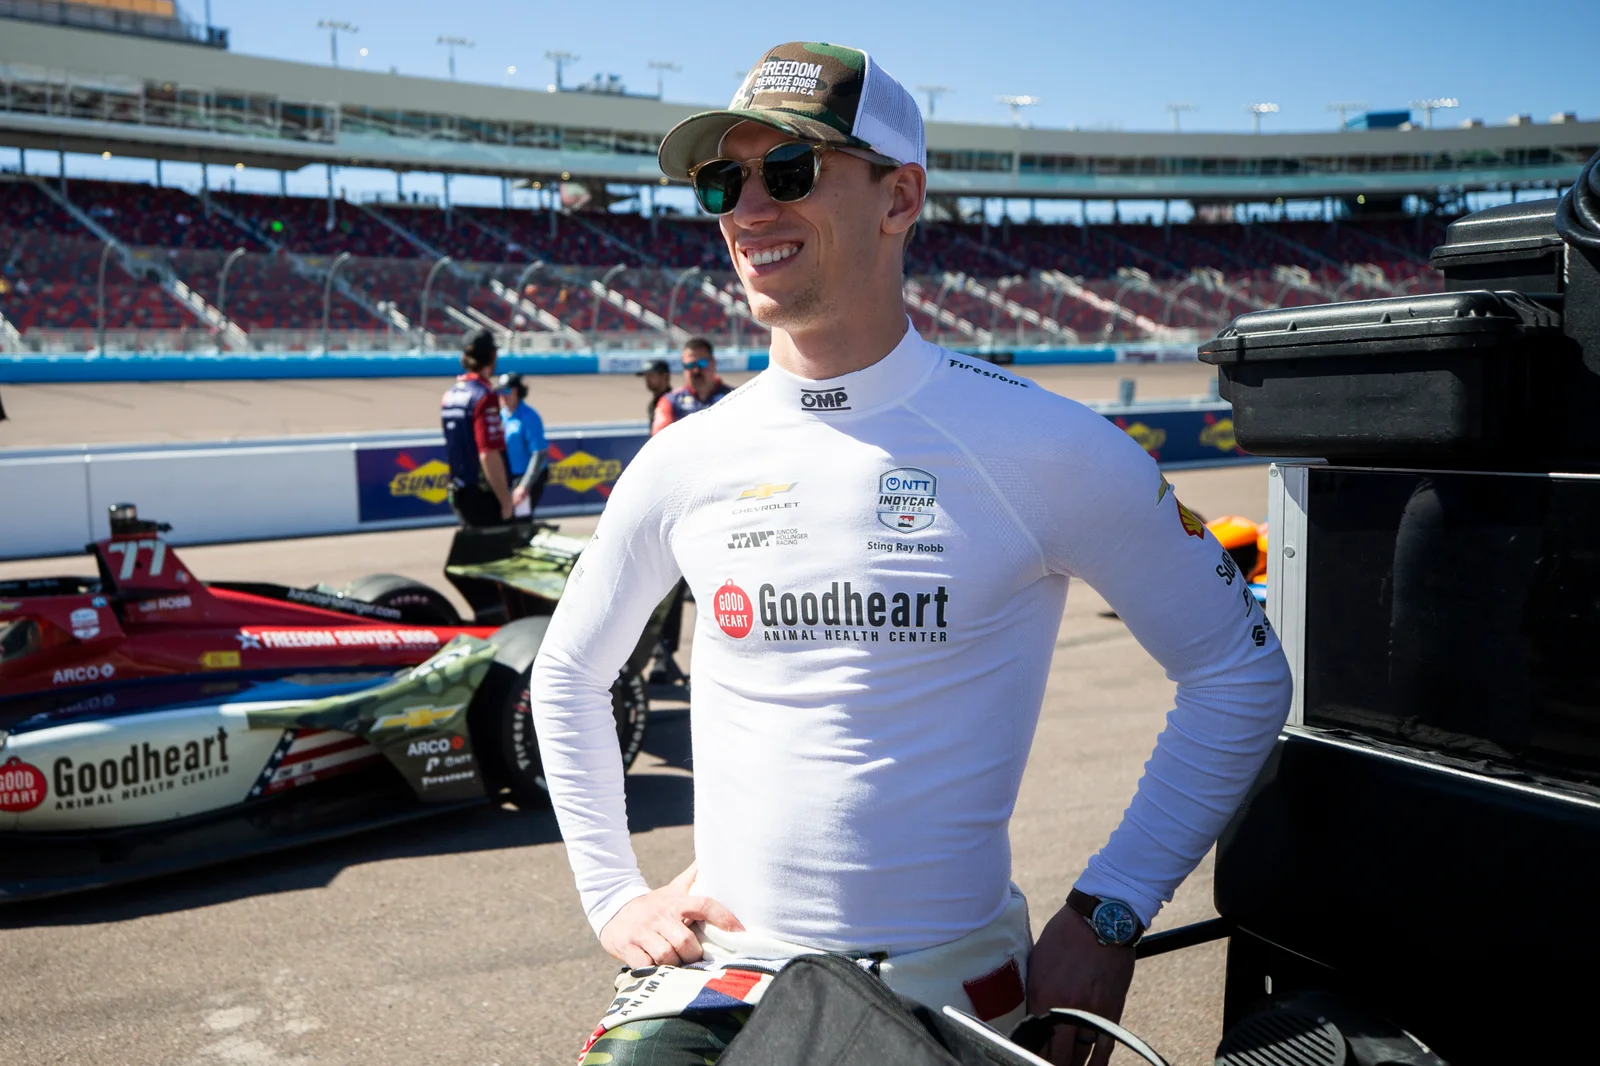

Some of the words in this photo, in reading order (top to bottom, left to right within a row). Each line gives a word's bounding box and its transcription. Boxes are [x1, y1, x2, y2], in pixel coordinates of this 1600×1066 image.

[760, 60, 823, 79] FREEDOM
[754, 75, 793, 88] SERVICE
[792, 78, 818, 89] DOGS
[752, 86, 765, 95] OF
[768, 86, 815, 96] AMERICA
[949, 358, 1030, 389] Firestone
[801, 390, 849, 409] OMP
[902, 479, 930, 491] NTT
[732, 501, 801, 515] CHEVROLET
[878, 495, 936, 507] INDYCAR
[889, 505, 923, 513] SERIES
[776, 533, 809, 541] HOLLINGER
[867, 541, 893, 553] Sting
[896, 542, 915, 554] Ray
[917, 543, 944, 553] Robb
[108, 539, 167, 580] 77
[158, 595, 192, 610] ROBB
[718, 591, 745, 612] GOOD
[759, 581, 949, 628] Goodheart
[719, 613, 748, 629] HEART
[261, 630, 337, 648] FREEDOM
[334, 630, 401, 645] SERVICE
[764, 630, 817, 641] ANIMAL
[825, 630, 880, 642] HEALTH
[889, 631, 947, 643] CENTER
[53, 665, 99, 684] ARCO
[407, 738, 450, 757] ARCO
[53, 725, 229, 798] Goodheart
[55, 793, 114, 811] ANIMAL
[121, 780, 175, 800] HEALTH
[182, 764, 230, 787] CENTER
